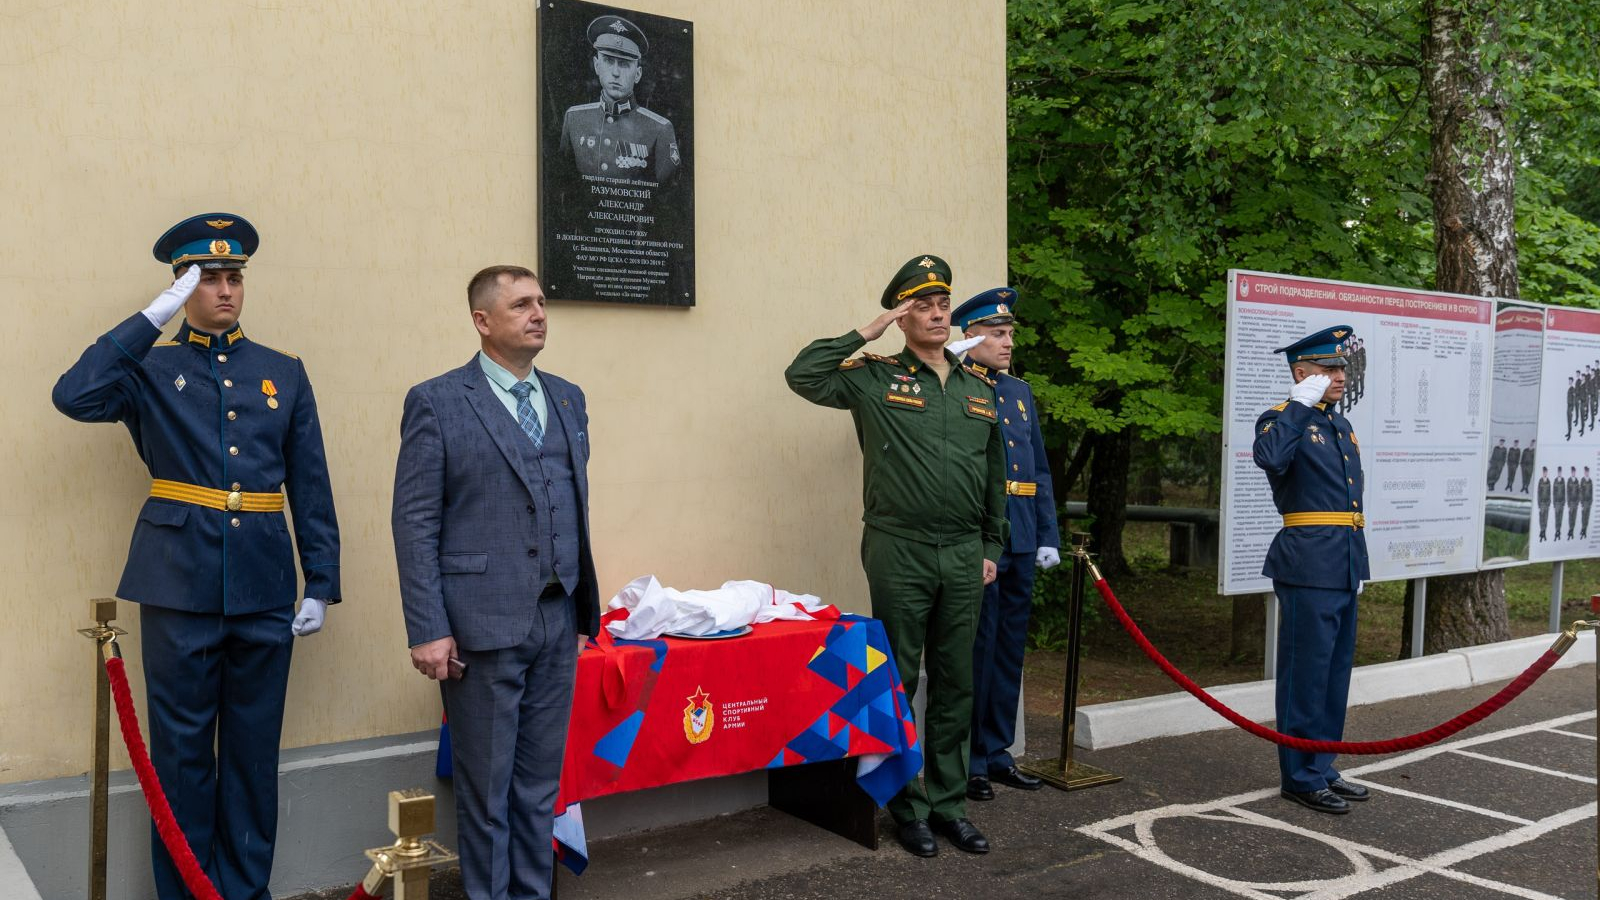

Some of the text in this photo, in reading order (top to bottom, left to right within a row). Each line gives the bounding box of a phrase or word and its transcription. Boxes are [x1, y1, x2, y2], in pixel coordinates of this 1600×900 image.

[606, 177, 630, 185] старший
[631, 179, 660, 188] лейтенант
[591, 185, 651, 199] РАЗУМОВСКИЙ
[598, 200, 645, 212] АЛЕКСАНДР
[588, 211, 655, 224] АЛЕКСАНДРОВИЧ
[594, 227, 624, 236] ПРОХОДИЛ
[562, 234, 598, 243] ДОЛЖНОСТИ
[598, 237, 630, 245] СТАРШИНЫ
[632, 239, 668, 248] СПОРТИВНОЙ
[580, 244, 610, 254] Балашиха,
[611, 247, 645, 256] Московская
[645, 249, 669, 258] область)
[1254, 283, 1278, 294] СТРОЙ
[1280, 286, 1338, 300] ПОДРАЗДЕЛЕНИЙ.
[1338, 292, 1384, 305] ОБЯЗАННОСТИ
[1384, 297, 1404, 308] ПЕРЕД
[1405, 300, 1448, 312] ПОСТРОЕНИЕМ
[1458, 304, 1478, 315] СТРОЮ
[722, 697, 768, 709] ЦЕНТРАЛЬНЫЙ
[722, 704, 765, 716] СПОРТИВНЫЙ
[723, 722, 746, 730] АРМИИ
